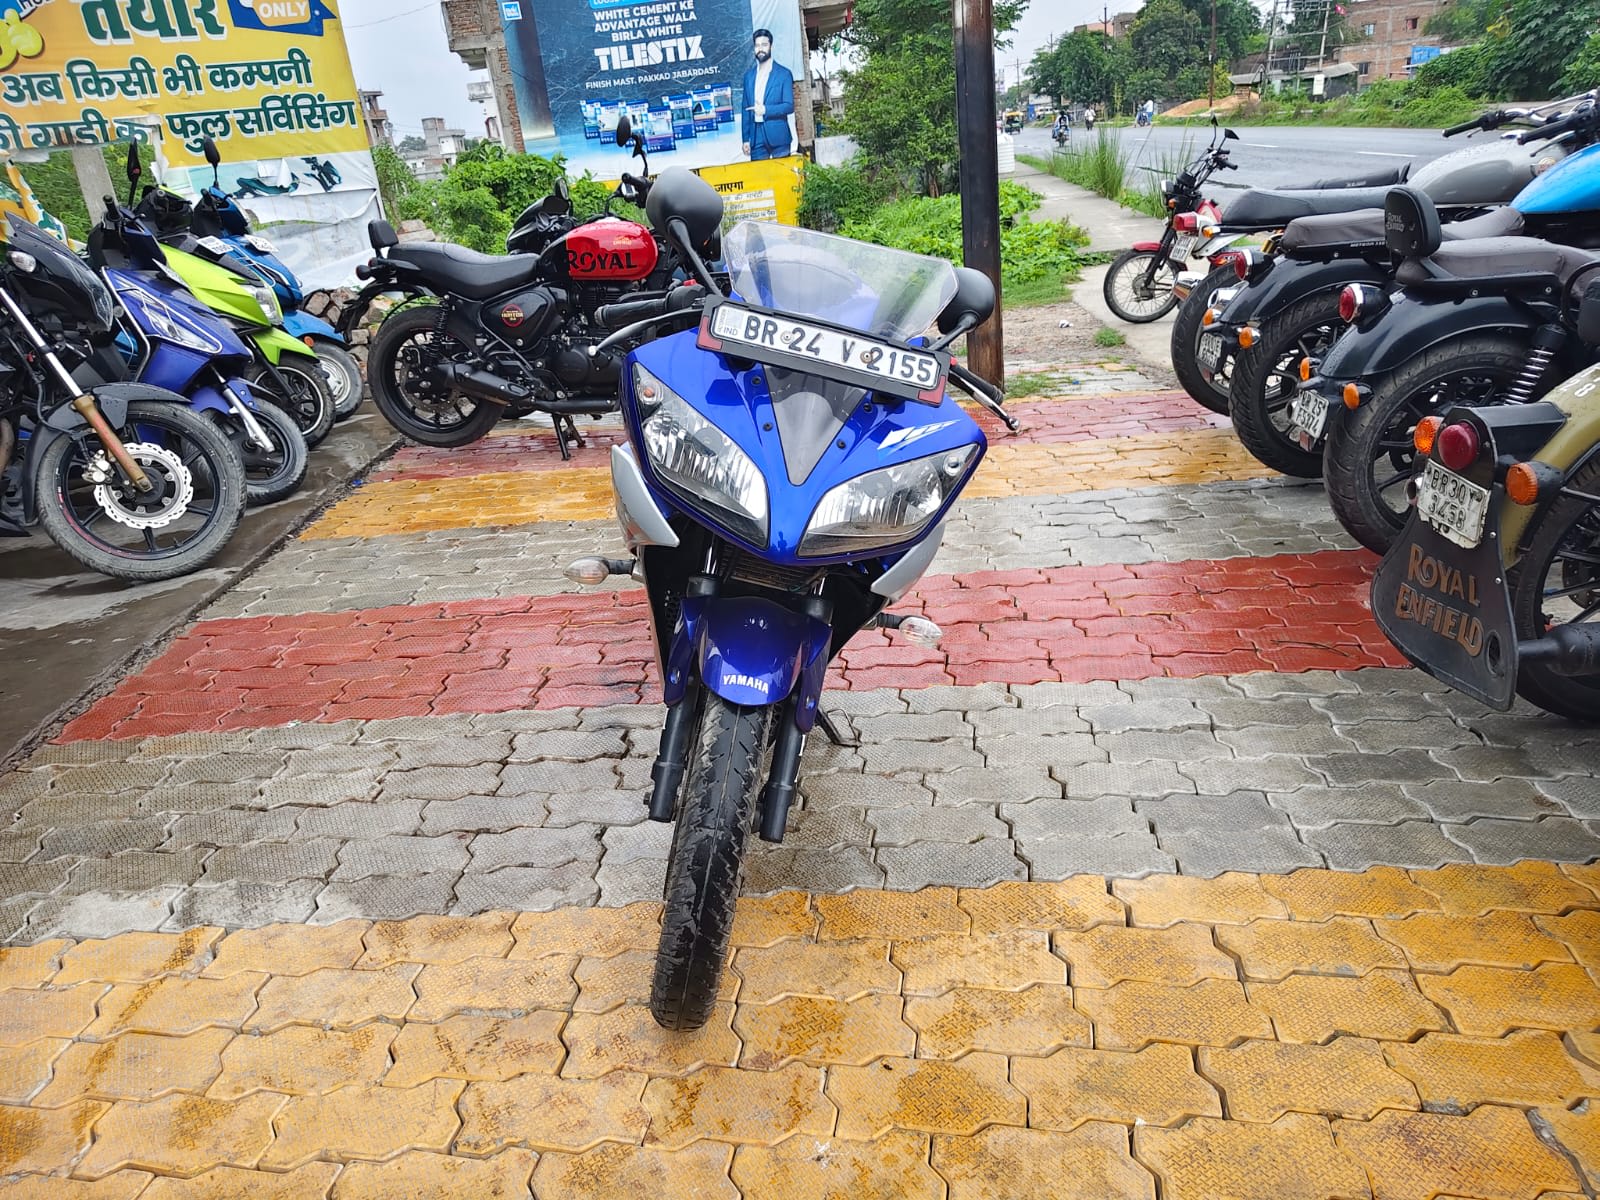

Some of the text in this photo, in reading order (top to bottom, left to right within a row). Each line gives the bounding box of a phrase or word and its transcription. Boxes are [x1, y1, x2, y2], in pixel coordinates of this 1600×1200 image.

[259, 1, 307, 18] ONLY
[593, 0, 695, 21] WHITE CEMENT KE
[594, 11, 697, 33] ADVANTAGE WALA
[611, 24, 683, 42] BIRLA WHITE
[594, 35, 705, 72] TILESTIX
[2, 49, 312, 103] अब किसी भी कम्पनी
[585, 66, 721, 90] FINISH MAST. PAKKAD JABARDAST.
[166, 111, 230, 150] फुल
[234, 94, 357, 134] सर्विसिंग
[568, 250, 637, 273] ROYAL
[723, 327, 738, 336] IND
[744, 315, 778, 345] BR
[787, 327, 821, 357] 24
[840, 338, 855, 363] V
[866, 346, 933, 383] 2155
[1407, 543, 1481, 607] ROYAL
[1395, 582, 1484, 656] ENFIELD
[722, 674, 769, 694] YAMAHA
